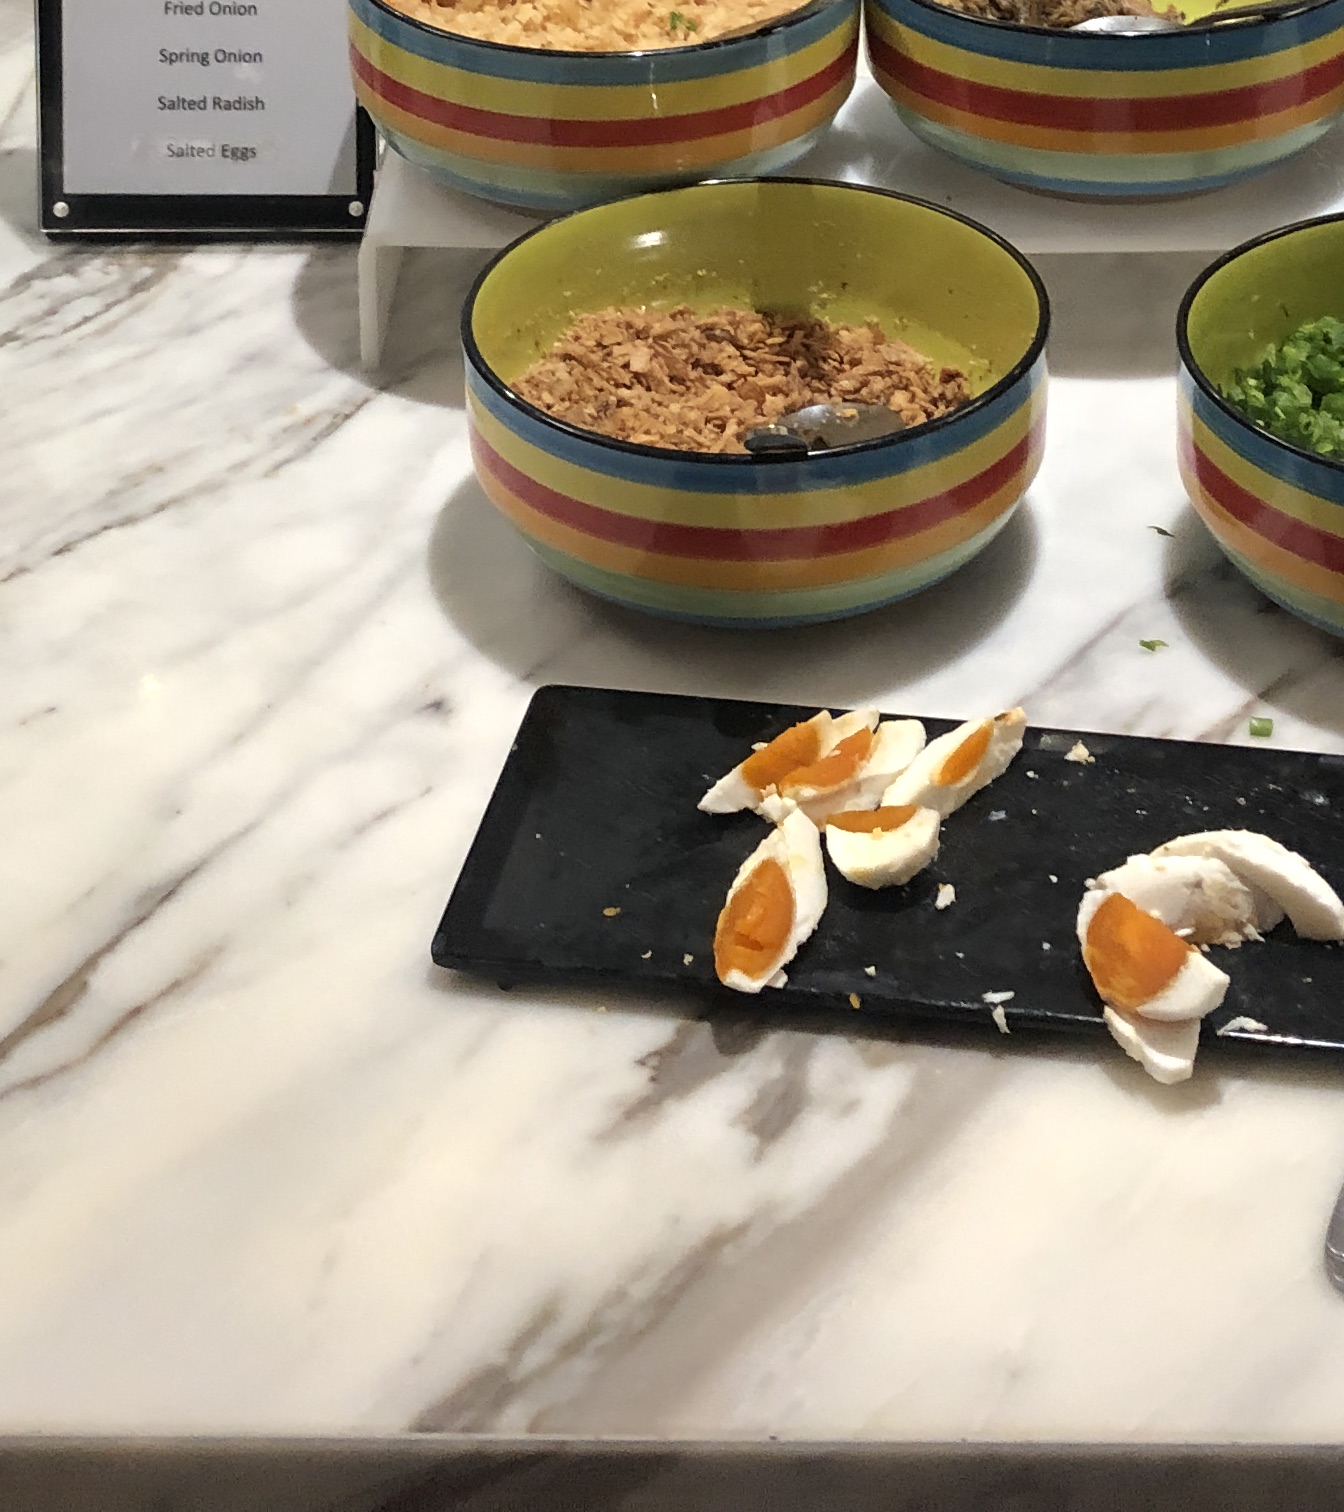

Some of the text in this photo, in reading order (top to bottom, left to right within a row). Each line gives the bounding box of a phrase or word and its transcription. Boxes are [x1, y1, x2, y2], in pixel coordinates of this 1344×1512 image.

[163, 0, 258, 16] Fried Onion
[158, 48, 263, 66] Spring Onion
[157, 95, 265, 111] Salted Radish
[166, 143, 257, 161] Salted Eggs
